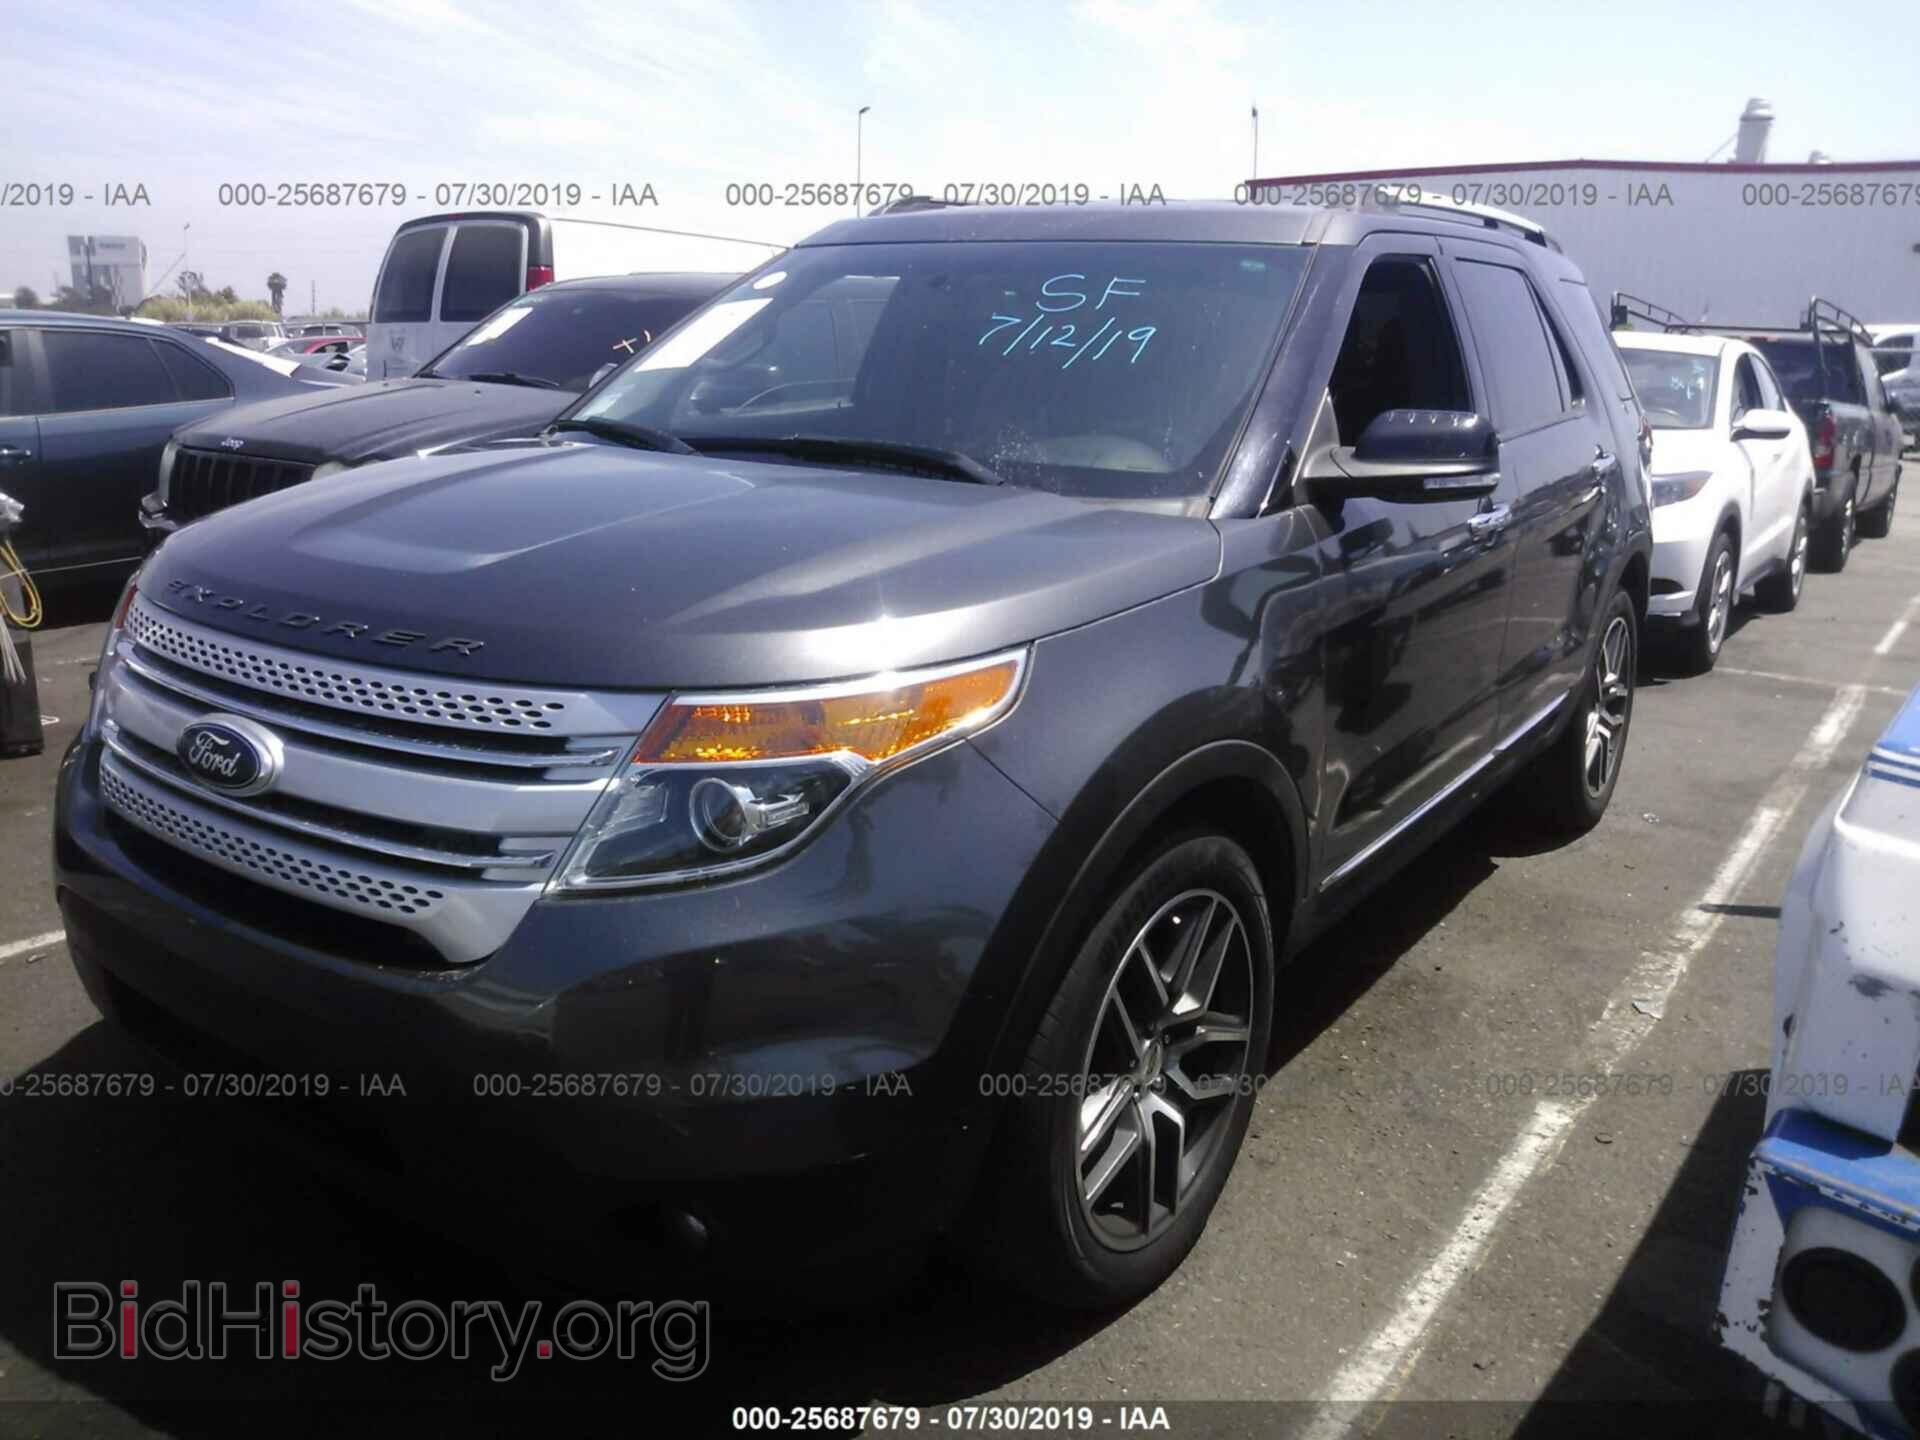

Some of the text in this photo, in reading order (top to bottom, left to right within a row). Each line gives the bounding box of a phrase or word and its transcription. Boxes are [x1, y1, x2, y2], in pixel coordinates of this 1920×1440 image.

[1035, 273, 1147, 313] SF
[978, 313, 1158, 370] 7/12/19
[167, 578, 486, 657] EXPLORER
[189, 730, 241, 778] Ford
